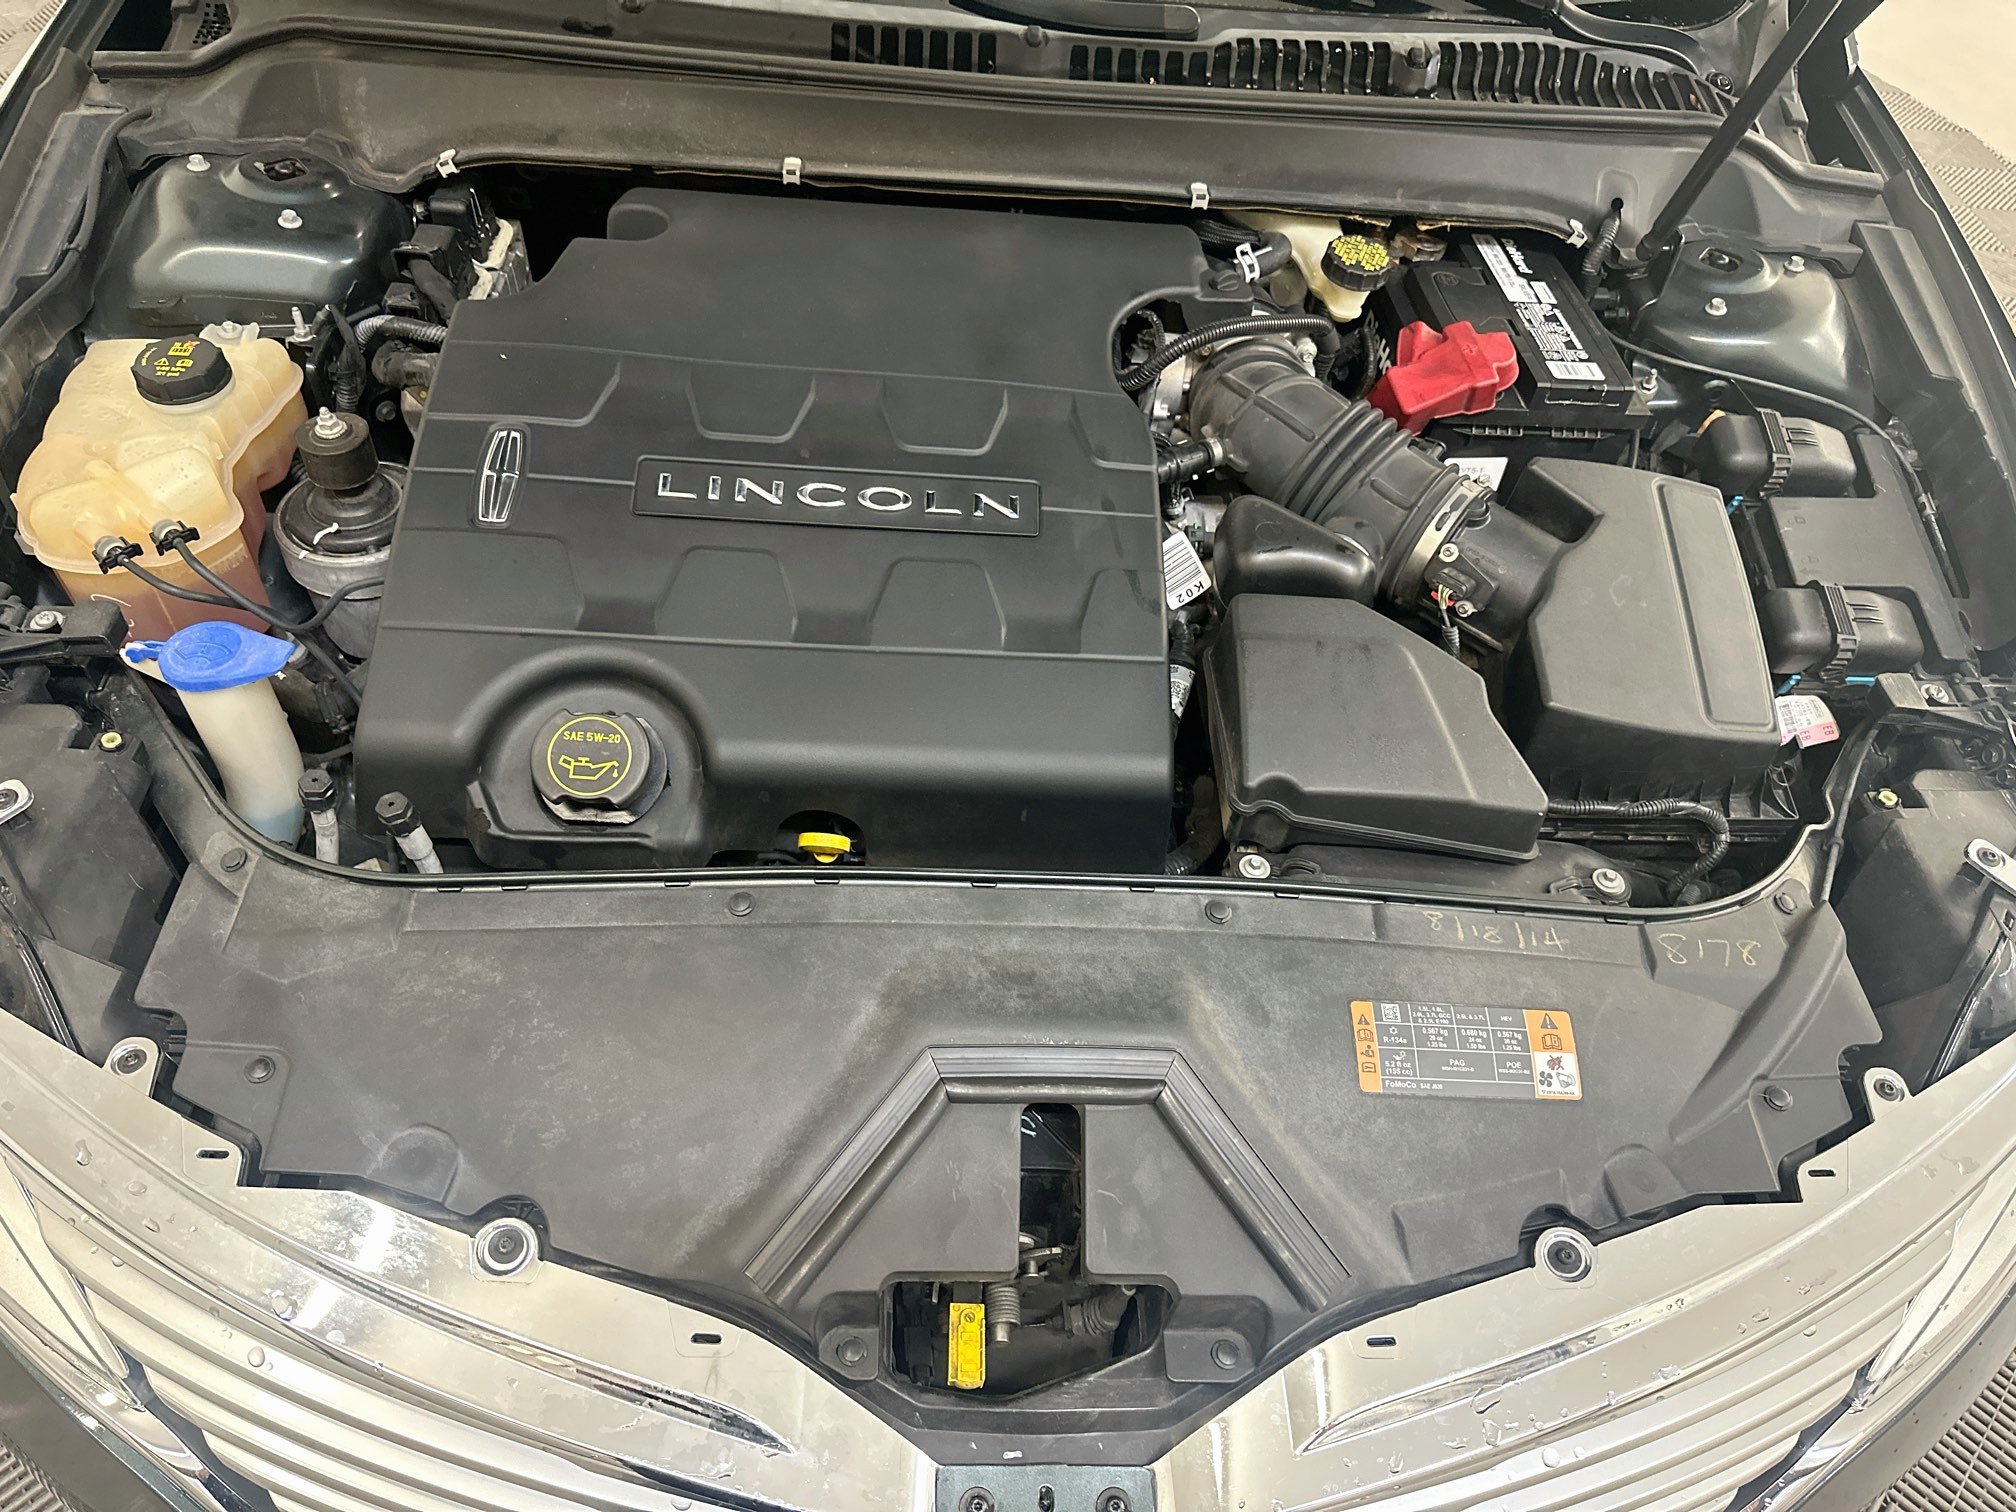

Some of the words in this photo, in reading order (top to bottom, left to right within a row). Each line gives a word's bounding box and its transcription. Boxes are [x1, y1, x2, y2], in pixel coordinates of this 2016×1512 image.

[656, 472, 1020, 519] LINCOLN
[563, 731, 584, 742] SAE
[586, 732, 621, 744] 5W-20
[1383, 1036, 1408, 1044] R-134a
[1449, 1058, 1466, 1067] PAG
[1506, 1061, 1522, 1069] POE
[1386, 1068, 1401, 1076] (155
[1402, 1068, 1413, 1076] cc)
[1385, 1080, 1417, 1089] FoMoCo
